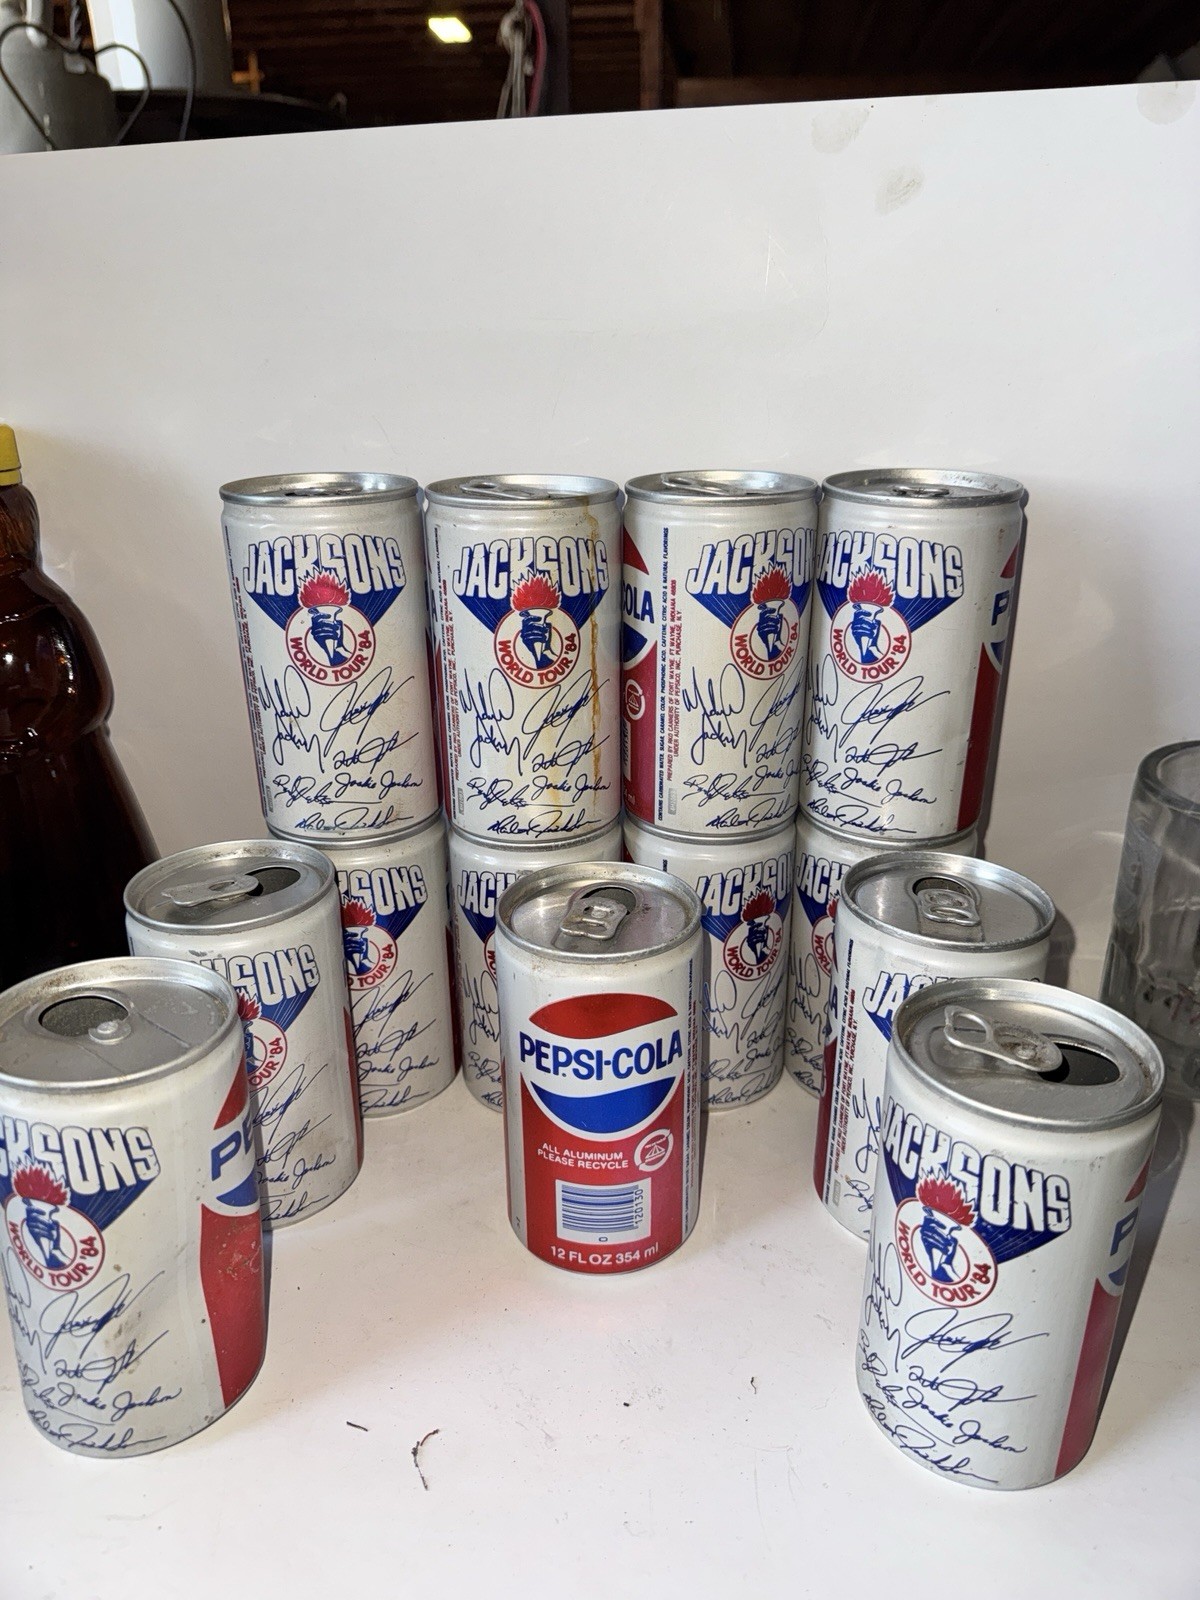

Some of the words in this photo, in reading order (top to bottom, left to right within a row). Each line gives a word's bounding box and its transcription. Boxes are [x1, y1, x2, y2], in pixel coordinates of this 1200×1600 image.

[243, 533, 406, 596] JACKSONS
[452, 535, 610, 599] JACKSONS
[685, 527, 815, 595] JACKSON
[290, 636, 328, 681] WORLD
[331, 655, 369, 682] TOUR
[358, 630, 373, 652] '84
[498, 639, 534, 684] WORLD
[538, 657, 573, 685] TOUR
[564, 633, 578, 655] '84
[734, 633, 764, 675] WORLD
[768, 649, 794, 675] TOUR
[833, 628, 857, 675] WORLD
[861, 658, 900, 680] TOUR
[892, 635, 907, 655] '84
[457, 870, 518, 918] JACK
[796, 853, 851, 904] JACK
[358, 965, 390, 987] TOUR
[382, 943, 395, 962] '84
[727, 946, 753, 978] WORLD
[757, 948, 778, 975] TOUR
[815, 935, 832, 974] WORL
[249, 1061, 280, 1086] OUR
[269, 1037, 284, 1059] '84
[519, 1029, 683, 1080] PEPSI-COLA
[0, 1115, 161, 1195] KSONS
[537, 1149, 575, 1167] PLEASE
[577, 1159, 629, 1170] RECYCLE
[542, 1142, 561, 1155] ALL
[563, 1149, 623, 1160] ALUMINUM
[8, 1221, 44, 1279] WORLD
[49, 1261, 94, 1287] TOUR
[80, 1235, 99, 1260] '84
[550, 1245, 566, 1259] 12
[569, 1251, 587, 1264] FL
[589, 1254, 613, 1265] OZ
[615, 1250, 640, 1264] 354
[644, 1241, 659, 1258] ml
[897, 1221, 926, 1287] WORLD
[931, 1285, 975, 1302] TOUR
[972, 1262, 991, 1287] '84
